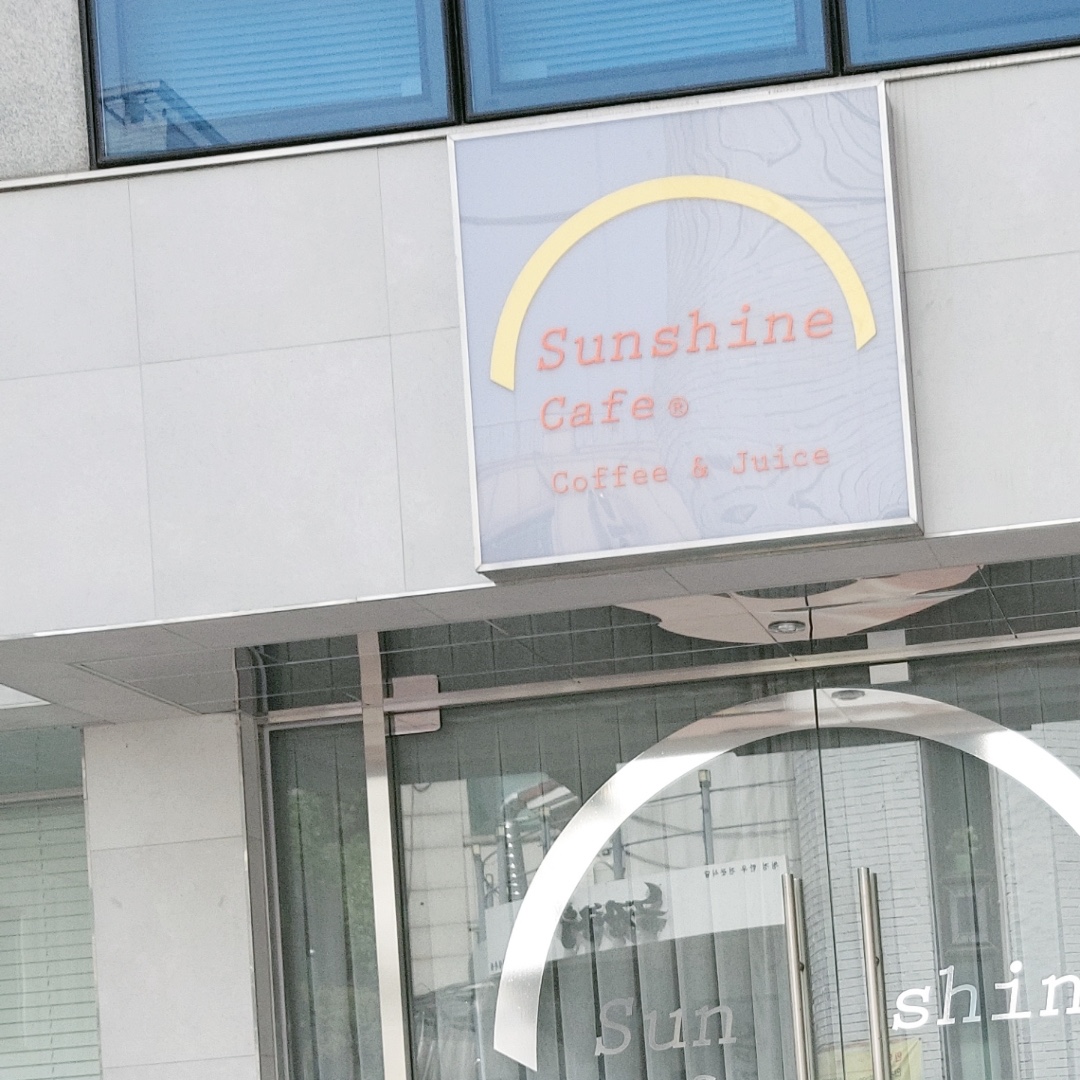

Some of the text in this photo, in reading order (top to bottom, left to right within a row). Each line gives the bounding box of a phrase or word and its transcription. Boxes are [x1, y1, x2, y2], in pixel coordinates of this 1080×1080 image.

[537, 304, 834, 371] Sunshine
[552, 445, 830, 494] Coffee & Juice
[594, 997, 738, 1056] Sun
